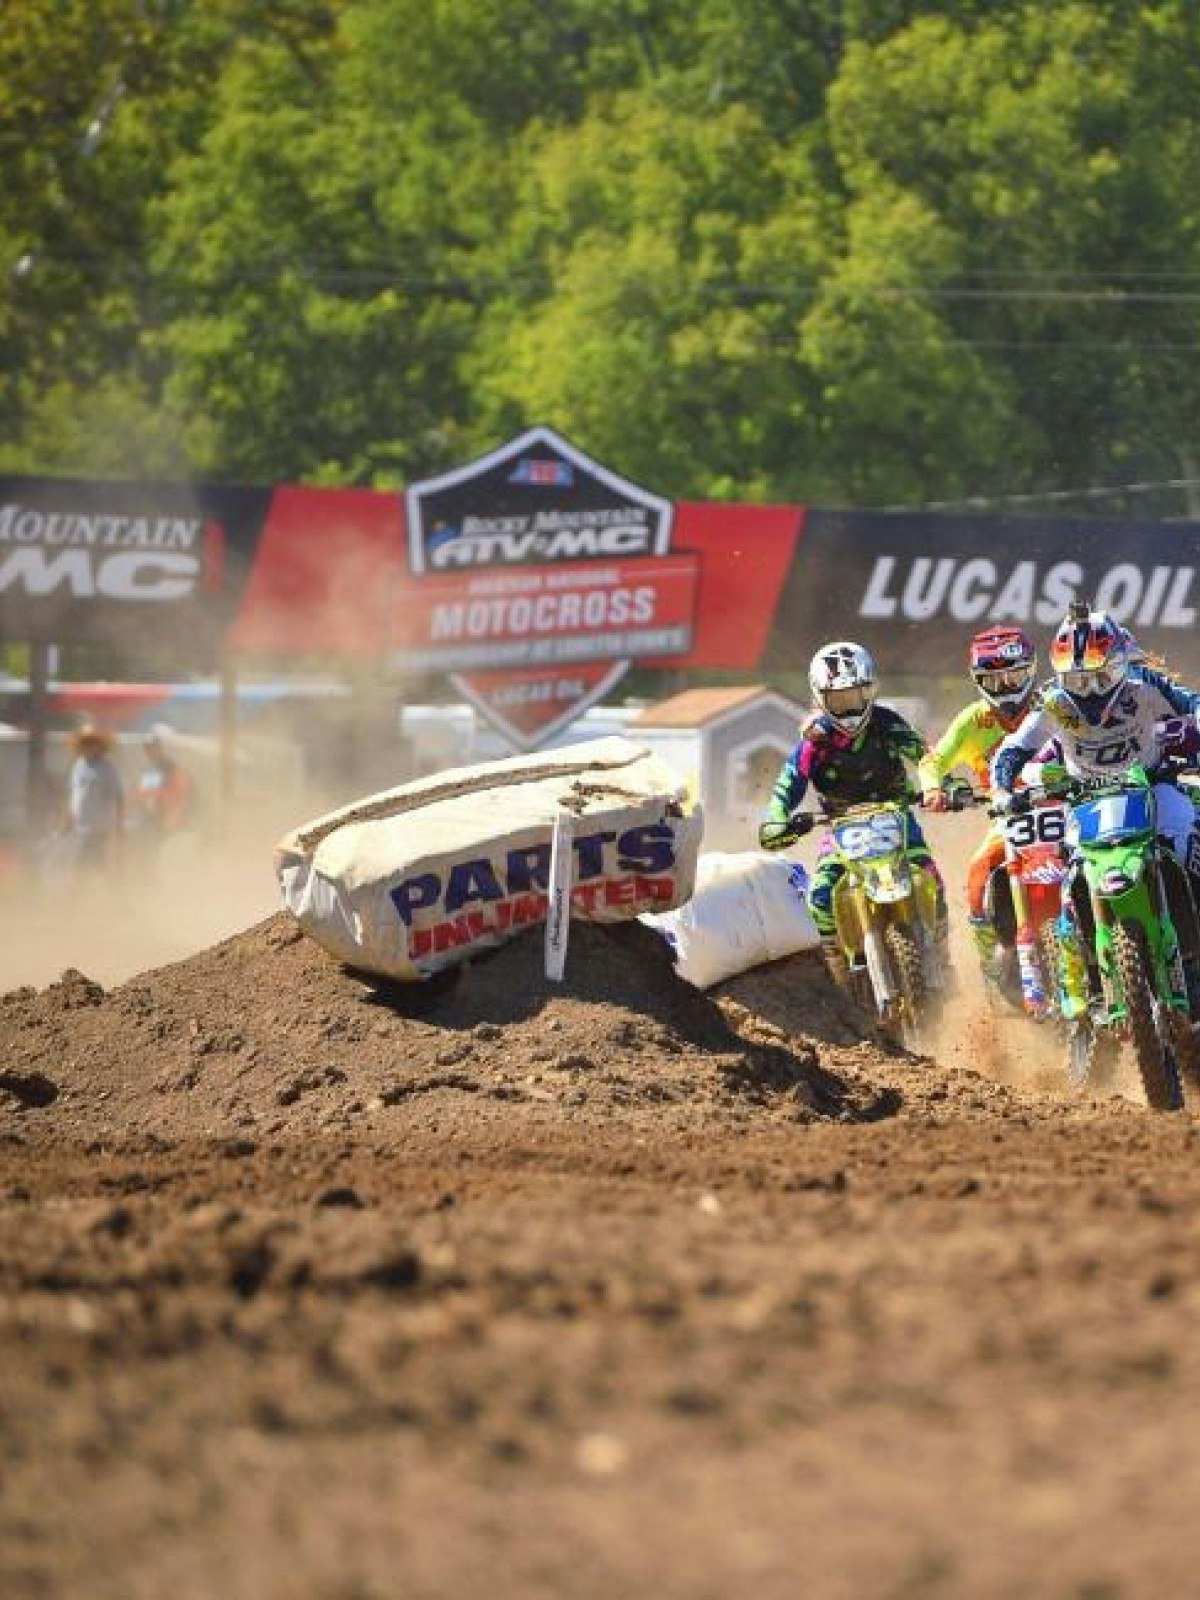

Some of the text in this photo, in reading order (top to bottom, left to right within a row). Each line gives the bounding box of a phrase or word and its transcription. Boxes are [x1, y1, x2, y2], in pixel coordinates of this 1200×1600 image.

[430, 586, 656, 640] MOTOCROSS
[858, 555, 1199, 627] LUCAS OIL
[1006, 810, 1065, 847] 36
[1090, 795, 1131, 839] 1
[391, 819, 677, 927] PARTS
